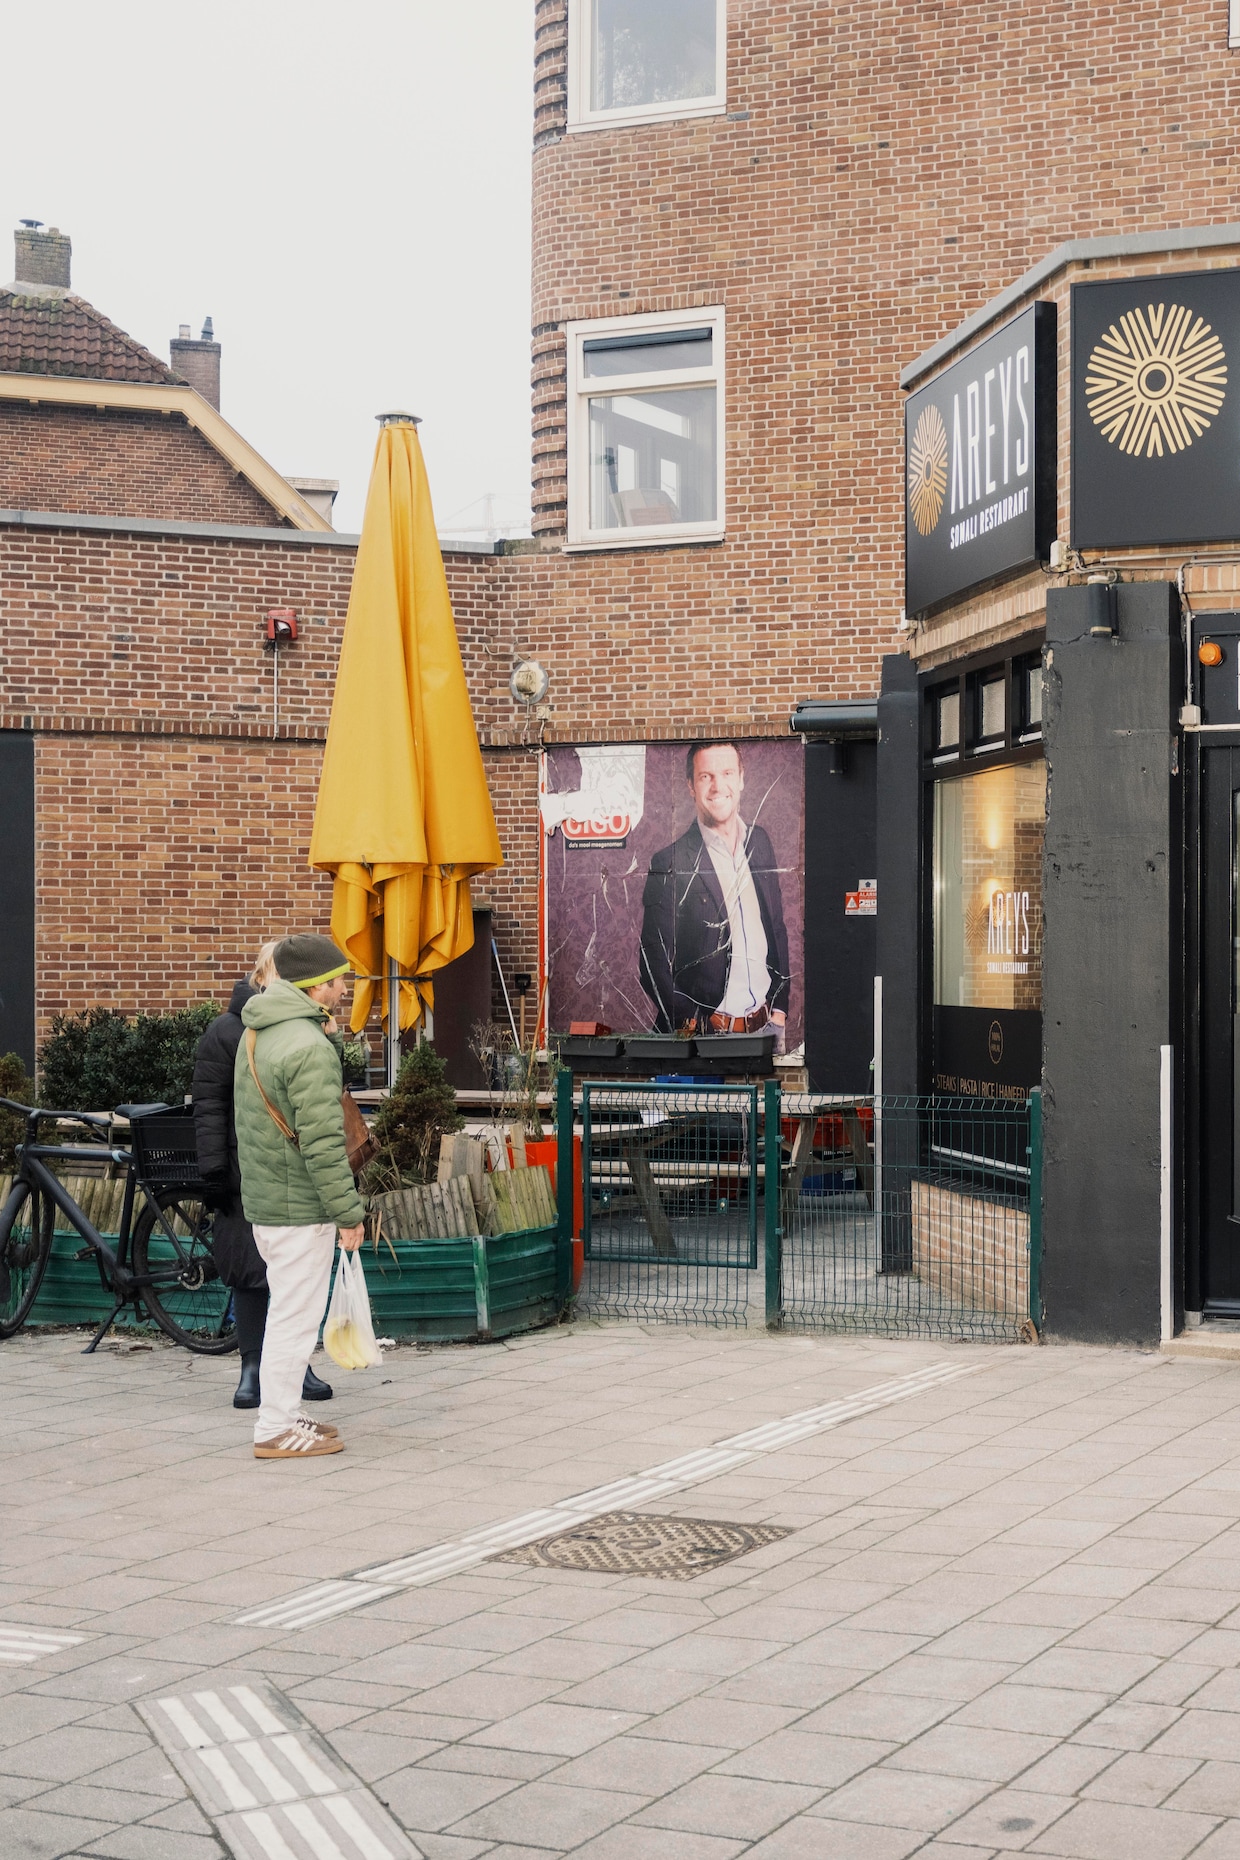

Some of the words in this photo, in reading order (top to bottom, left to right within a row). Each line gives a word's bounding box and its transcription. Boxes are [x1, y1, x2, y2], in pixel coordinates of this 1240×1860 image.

[951, 345, 1028, 514] AREYS
[950, 515, 977, 549] SOMALI
[980, 487, 1028, 534] RESTAURANT
[988, 891, 1029, 954] AREYS
[936, 1074, 957, 1092] STEAKS
[960, 1078, 977, 1096] PASTA
[982, 1081, 995, 1098] RICE
[1000, 1085, 1025, 1103] HANEED
